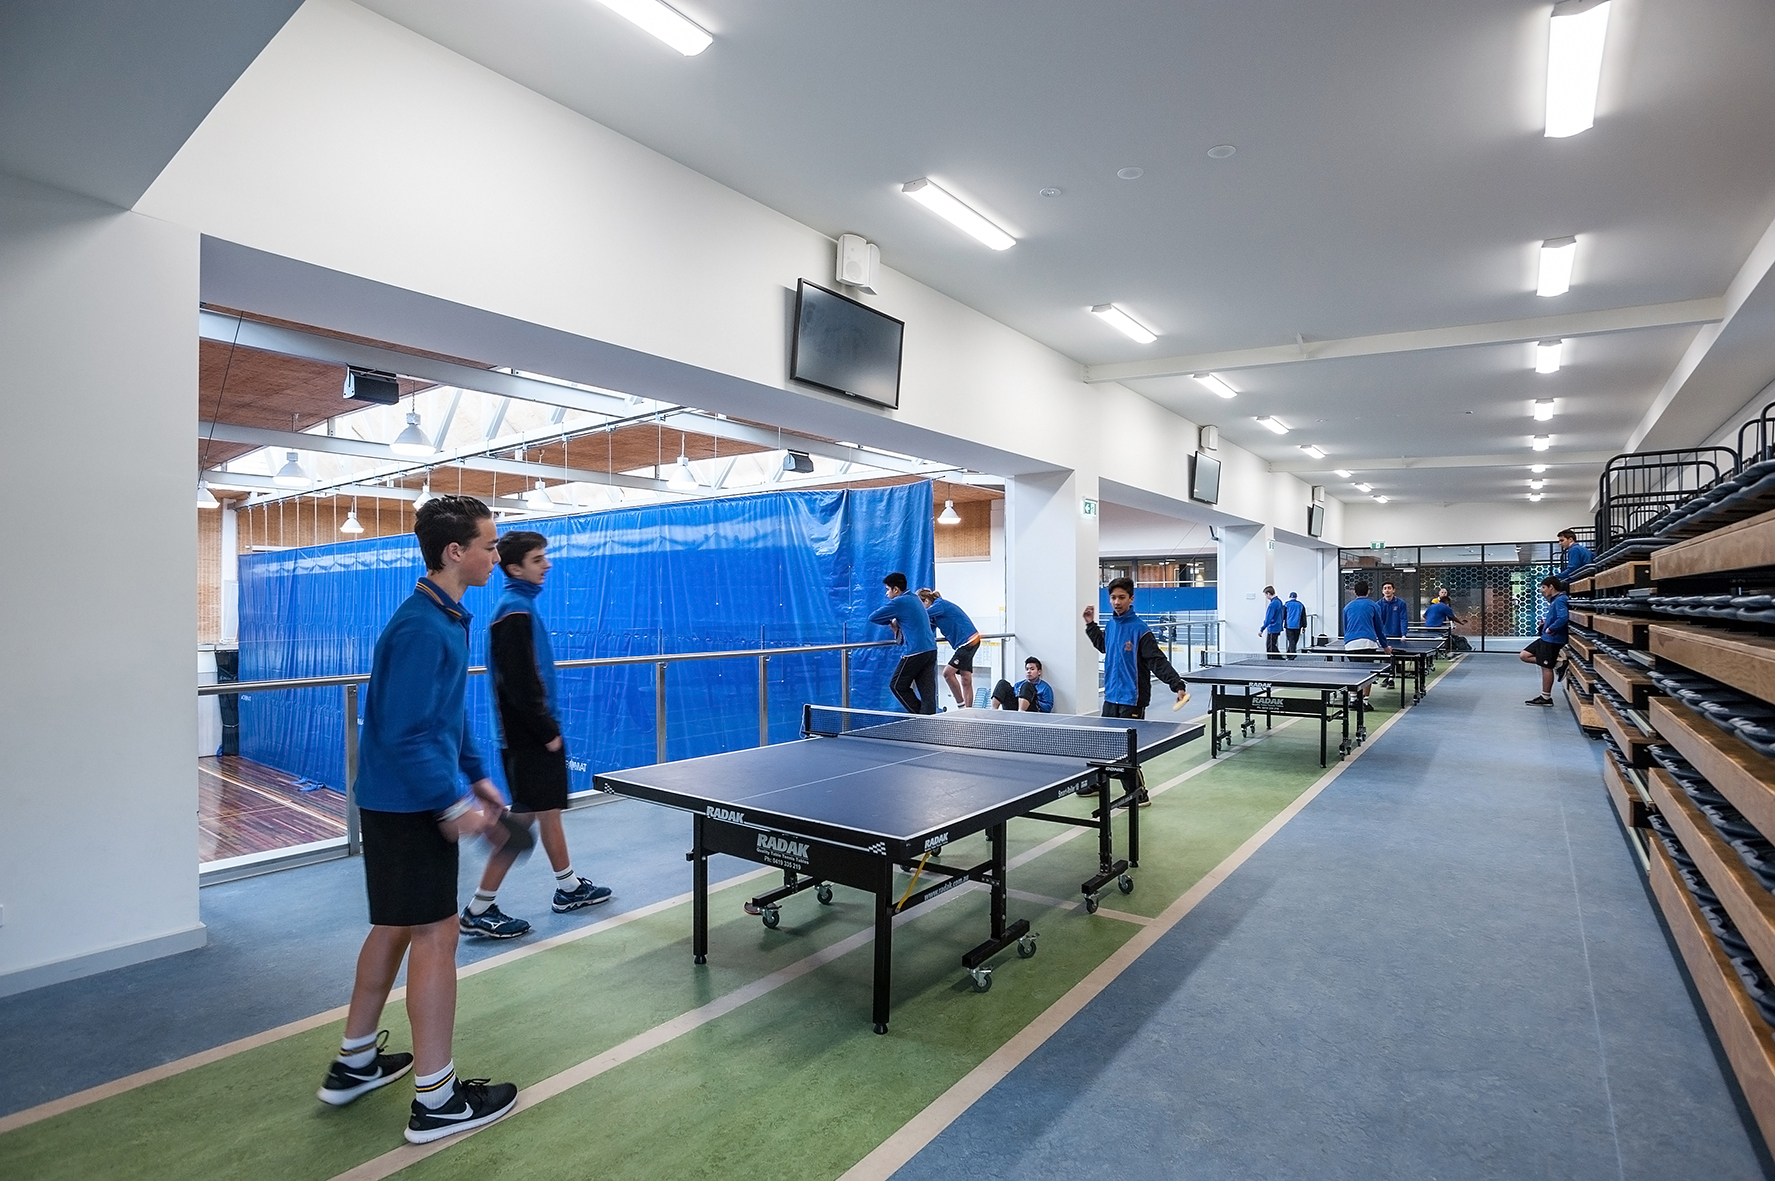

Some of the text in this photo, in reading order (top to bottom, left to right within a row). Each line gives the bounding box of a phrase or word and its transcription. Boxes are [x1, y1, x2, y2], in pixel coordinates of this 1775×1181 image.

[1252, 697, 1284, 705] RADAK
[706, 805, 745, 824] RADAK
[756, 833, 810, 858] RADAK
[924, 832, 949, 849] RADAK
